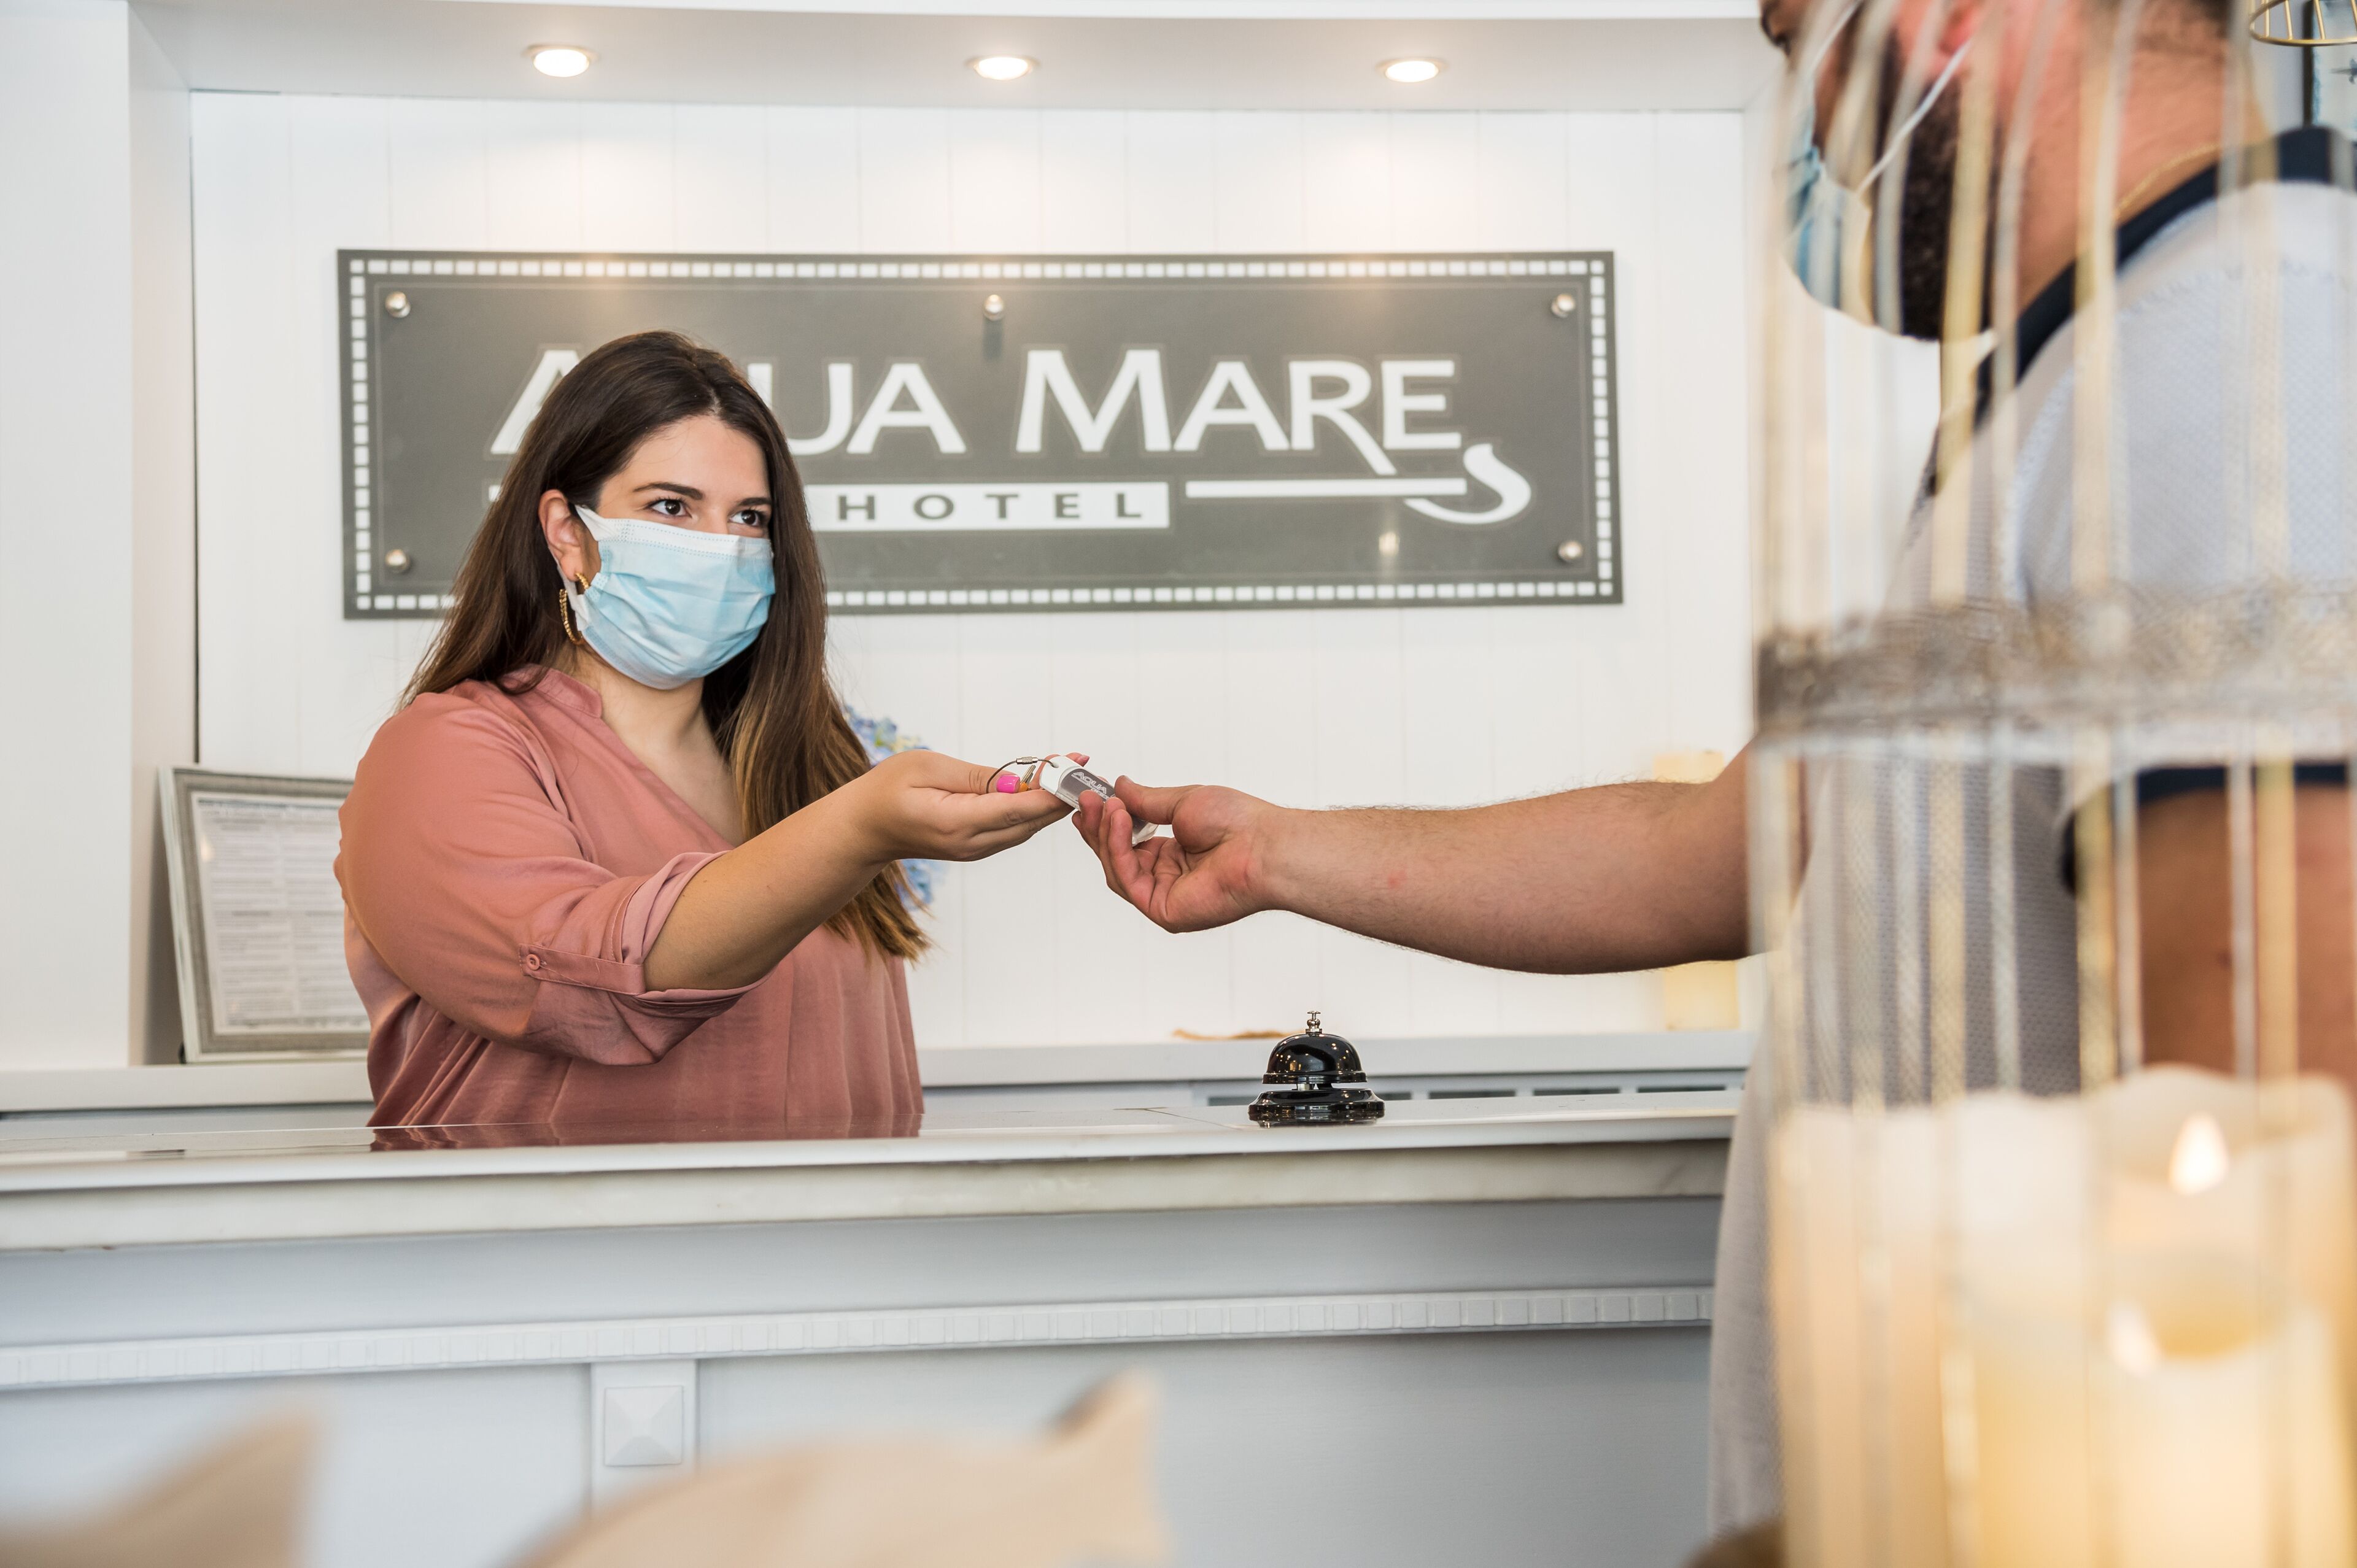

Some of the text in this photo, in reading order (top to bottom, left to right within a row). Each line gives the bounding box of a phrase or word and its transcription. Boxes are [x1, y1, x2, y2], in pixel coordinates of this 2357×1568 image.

[491, 350, 966, 454] AUA
[838, 493, 1142, 520] HOTEL
[1073, 771, 1107, 794] AQUA
